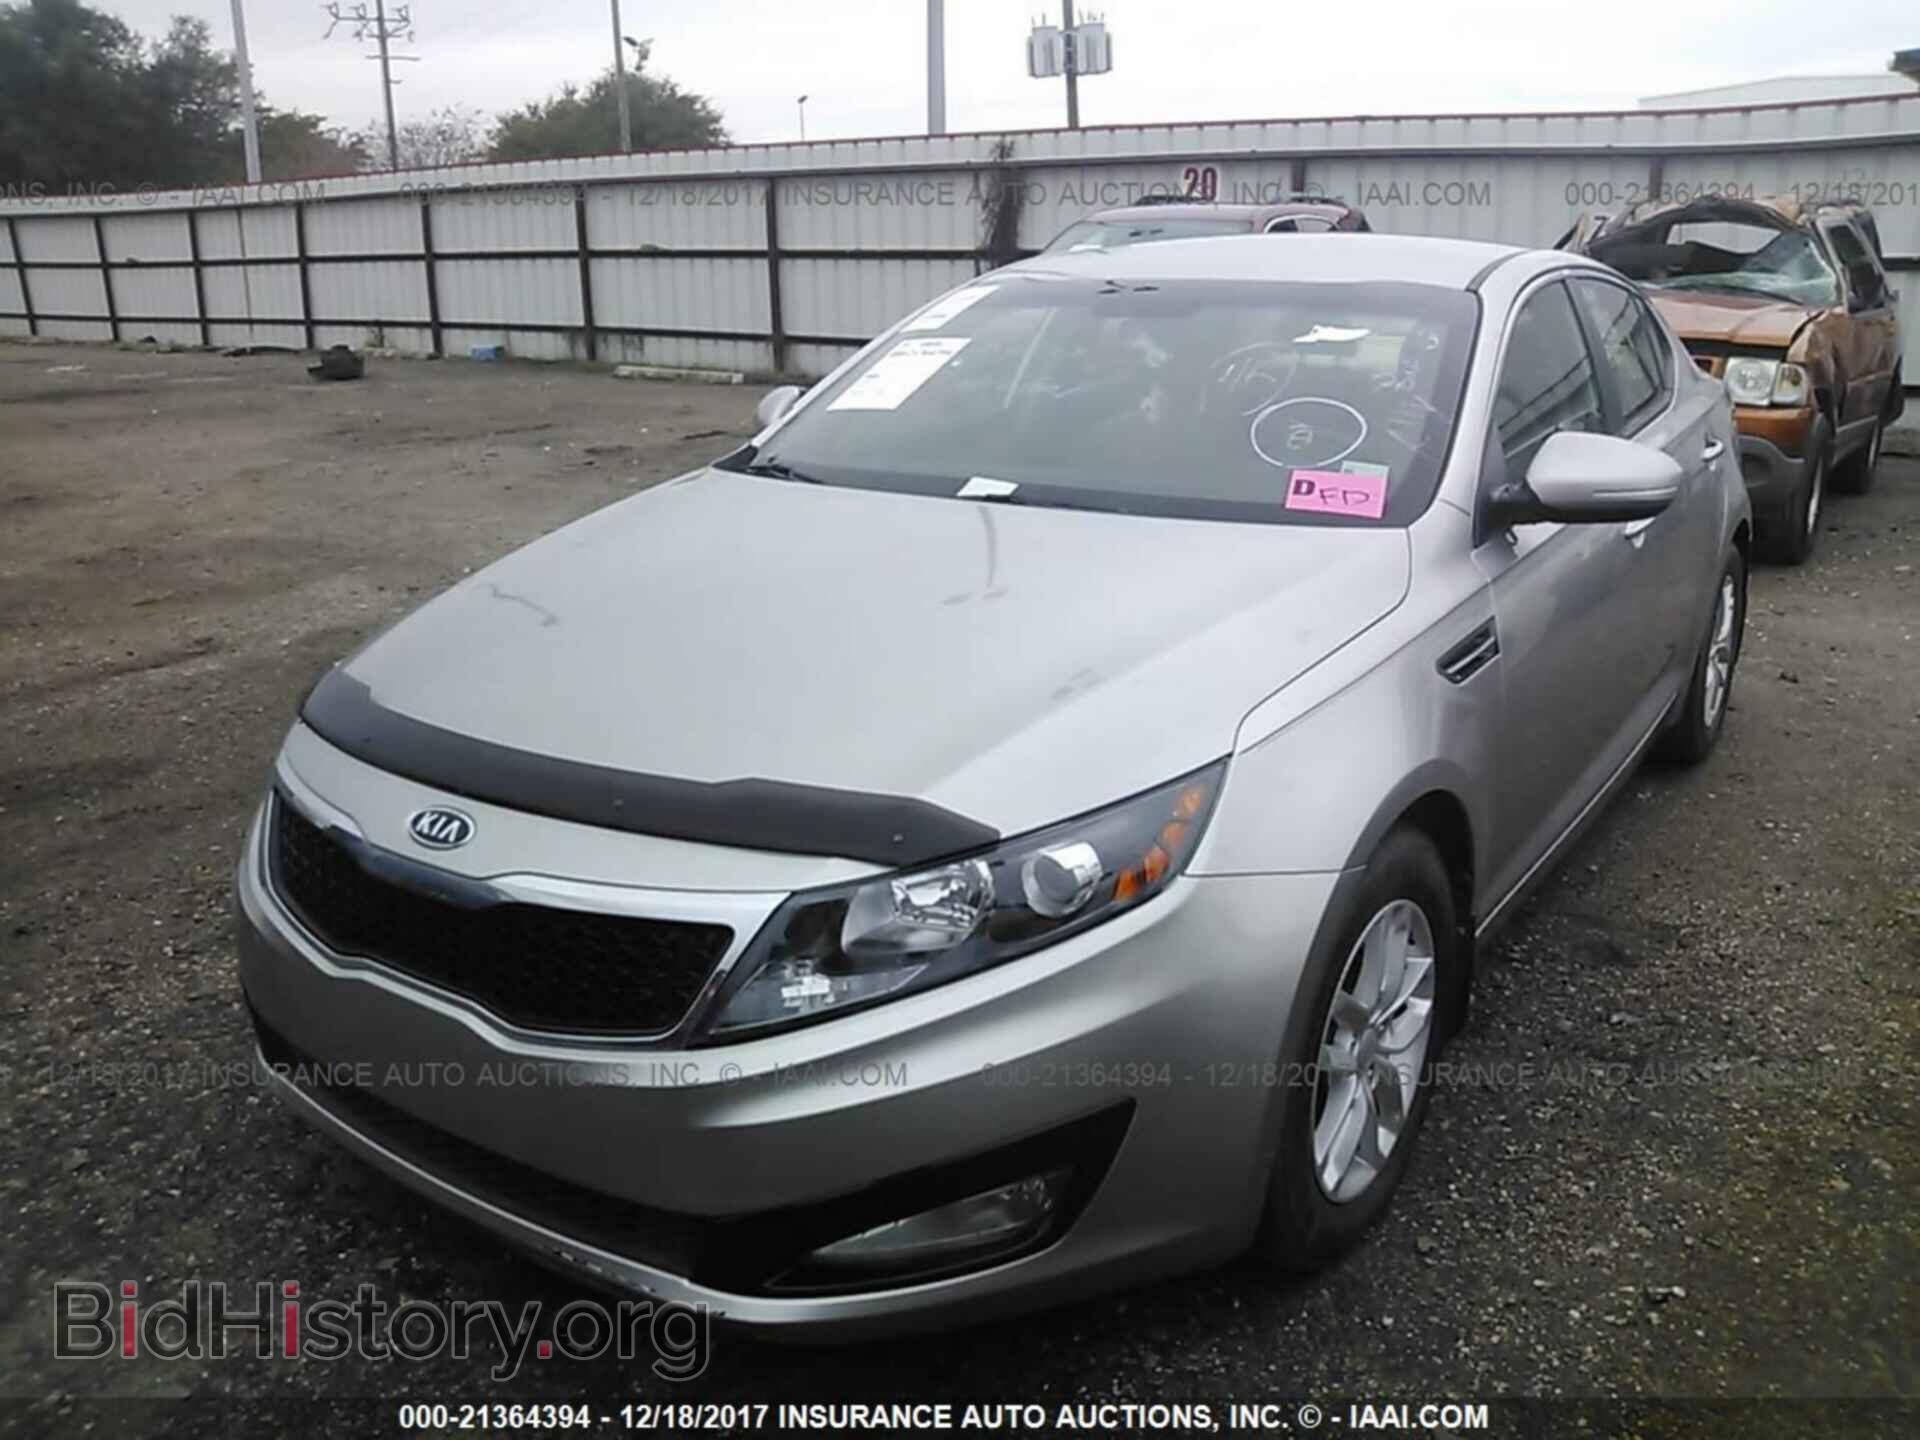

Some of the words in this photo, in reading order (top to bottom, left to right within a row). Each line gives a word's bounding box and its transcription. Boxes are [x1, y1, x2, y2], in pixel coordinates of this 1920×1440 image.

[1184, 167, 1218, 202] 20
[1292, 479, 1316, 497] D
[415, 811, 461, 842] KIA
